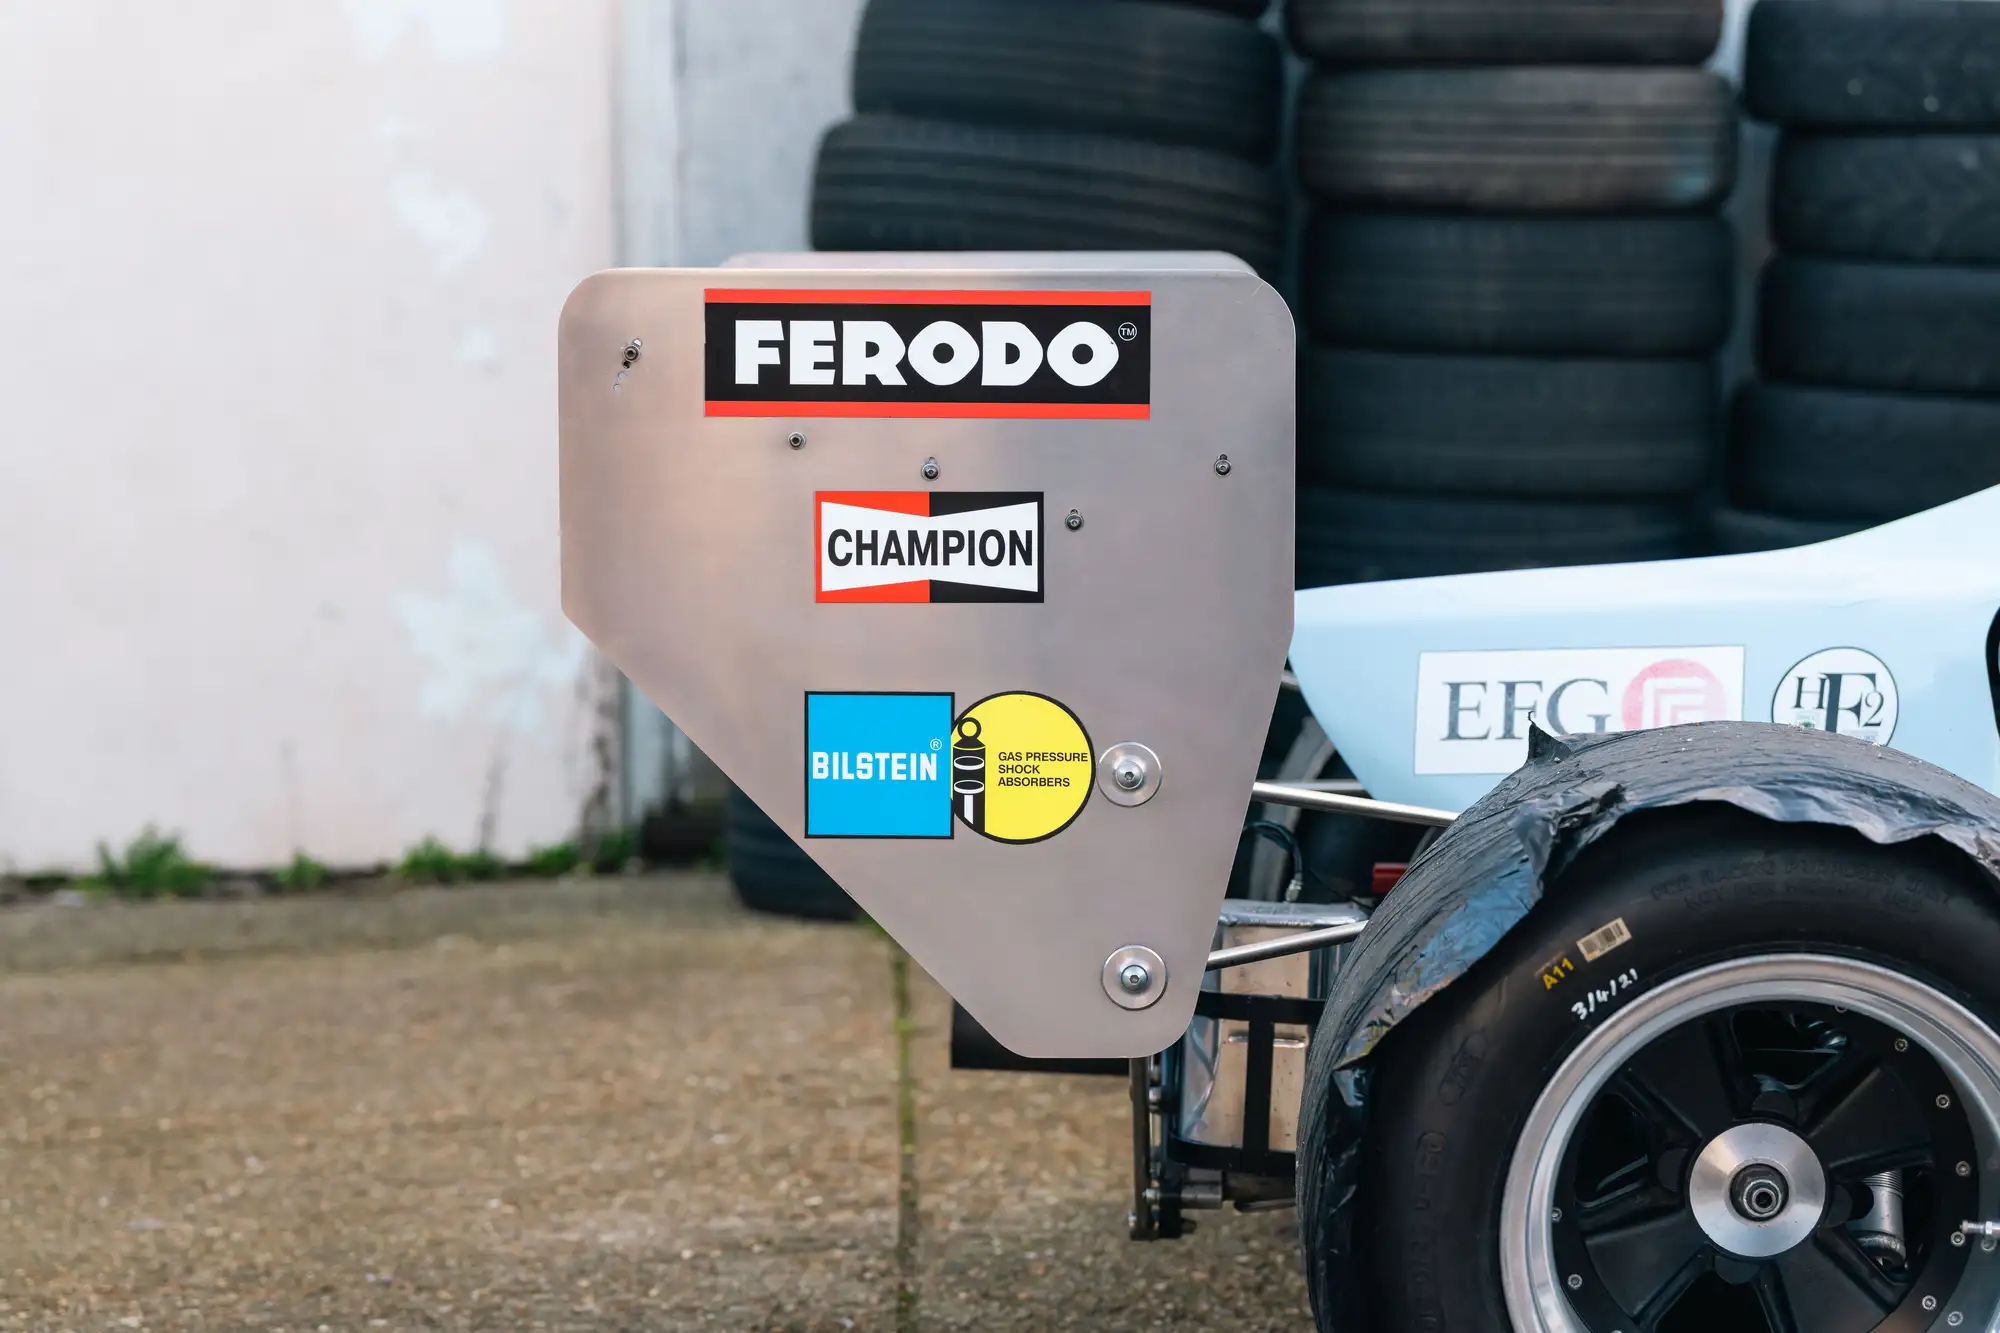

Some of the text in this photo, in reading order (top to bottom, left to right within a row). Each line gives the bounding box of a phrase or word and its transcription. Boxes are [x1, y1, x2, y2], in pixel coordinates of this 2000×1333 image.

[735, 319, 1120, 387] FERODO
[827, 528, 1033, 568] CHAMPION
[1440, 677, 1612, 742] EFG
[812, 751, 937, 781] BILSTEIN
[998, 751, 1089, 762] GAS PRESSURE
[998, 764, 1041, 775] SHOCK
[997, 776, 1071, 788] ABSORBERS
[1543, 957, 1575, 990] A11
[1571, 967, 1639, 1021] 3/4/21
